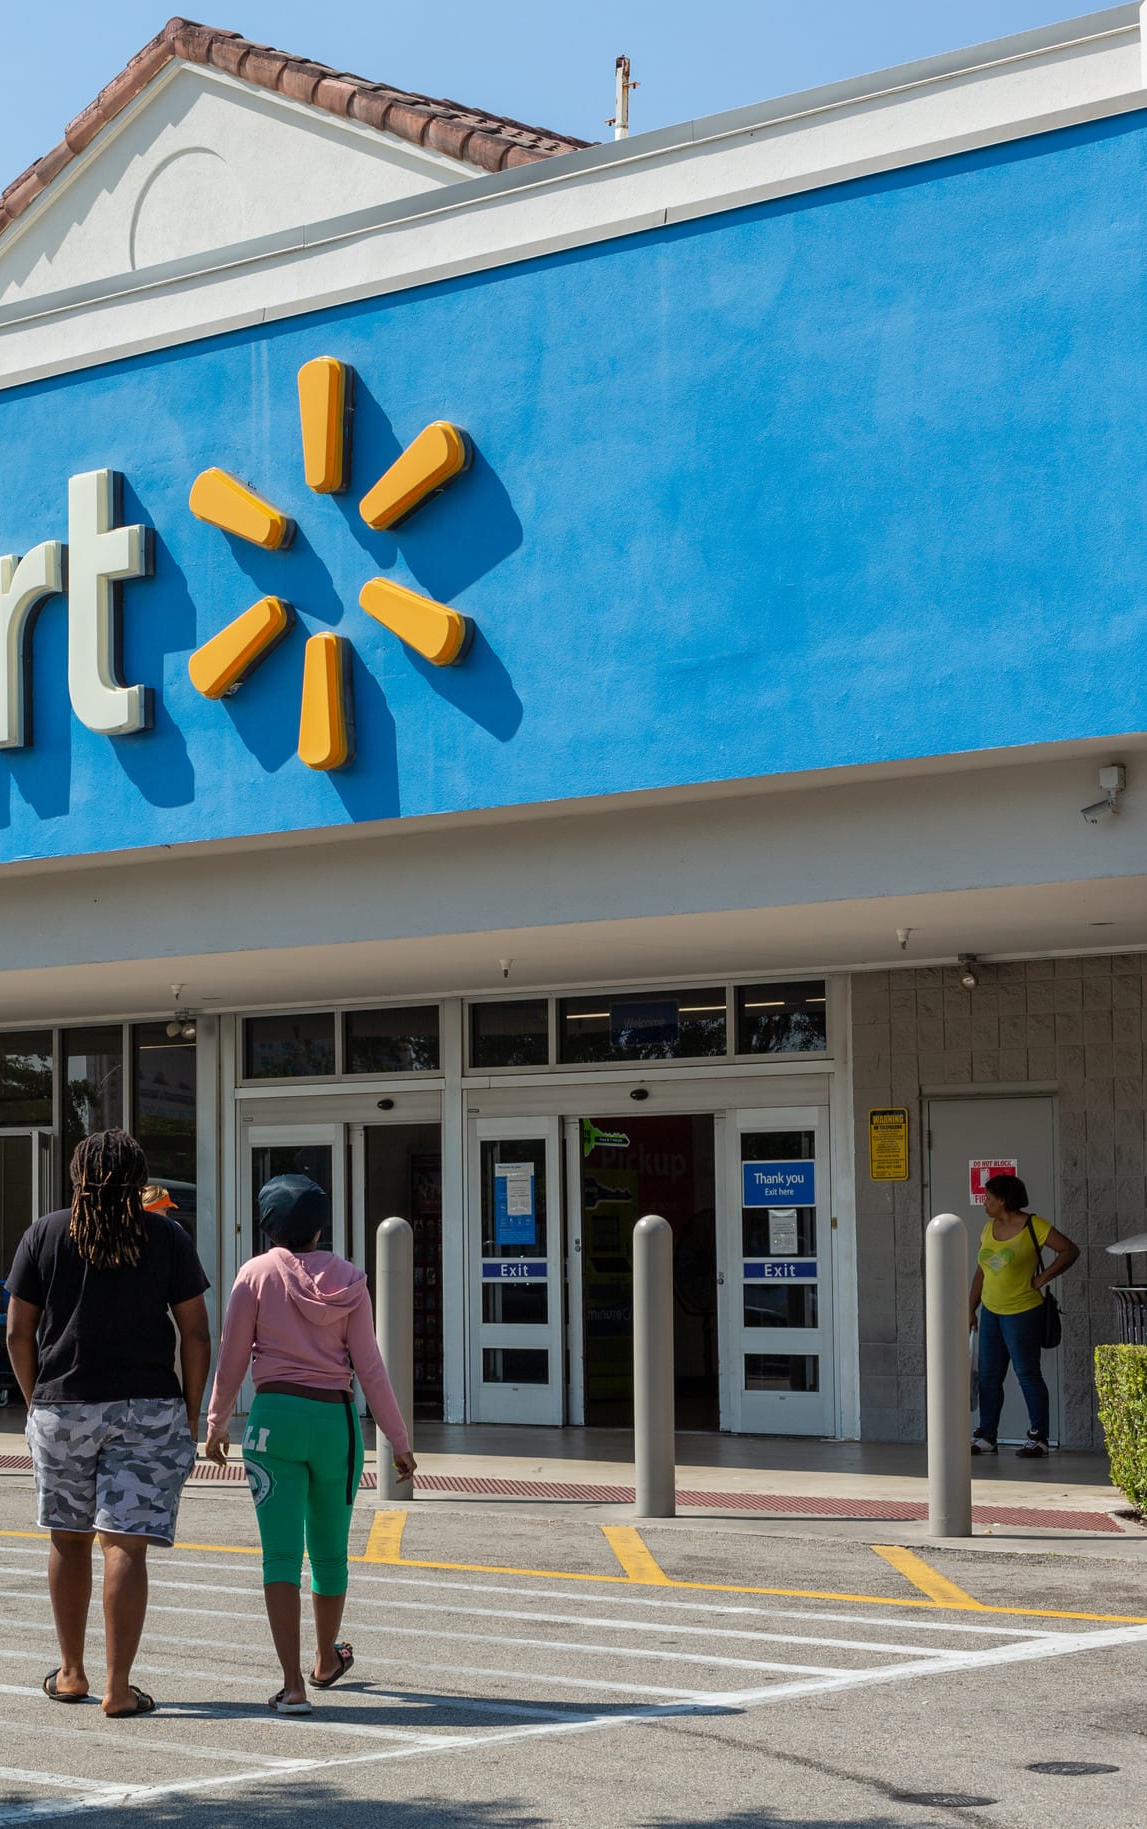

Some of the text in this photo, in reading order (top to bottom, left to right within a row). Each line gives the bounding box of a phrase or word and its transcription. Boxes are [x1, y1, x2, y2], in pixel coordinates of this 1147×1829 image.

[872, 1114, 904, 1124] WARNING
[754, 1171, 805, 1187] Thank you
[764, 1187, 795, 1197] Exit here
[500, 1263, 529, 1277] Exit
[763, 1263, 796, 1278] Exit
